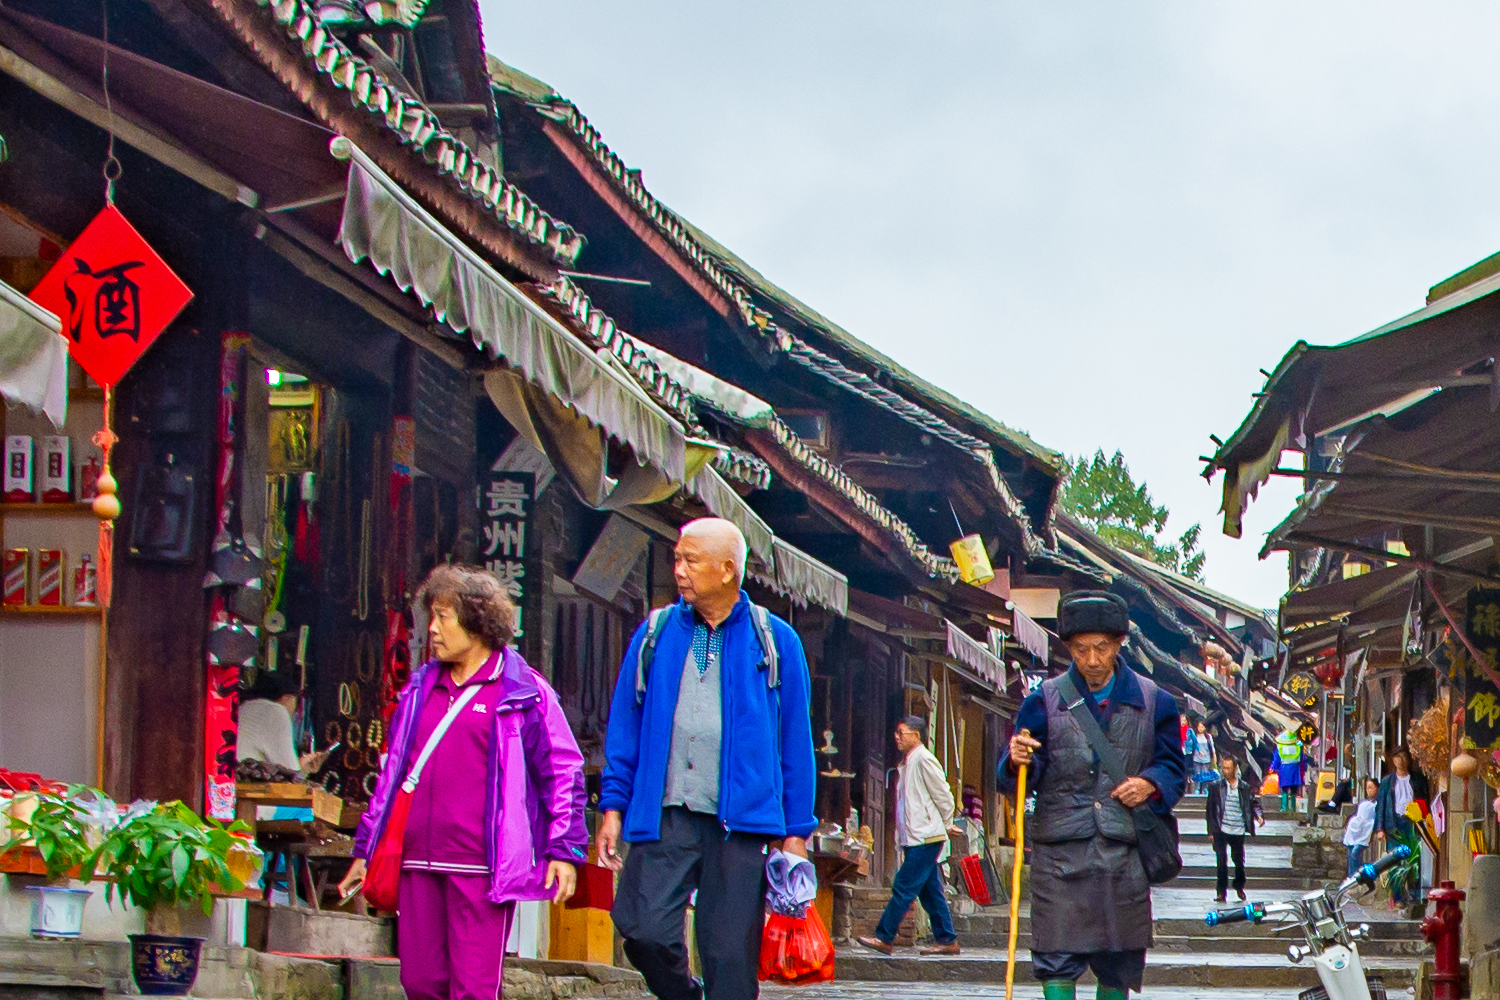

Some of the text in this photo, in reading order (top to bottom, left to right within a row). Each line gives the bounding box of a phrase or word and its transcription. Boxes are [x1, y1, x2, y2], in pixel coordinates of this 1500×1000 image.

[64, 258, 146, 343] 酒
[484, 479, 530, 650] 贵州紫
